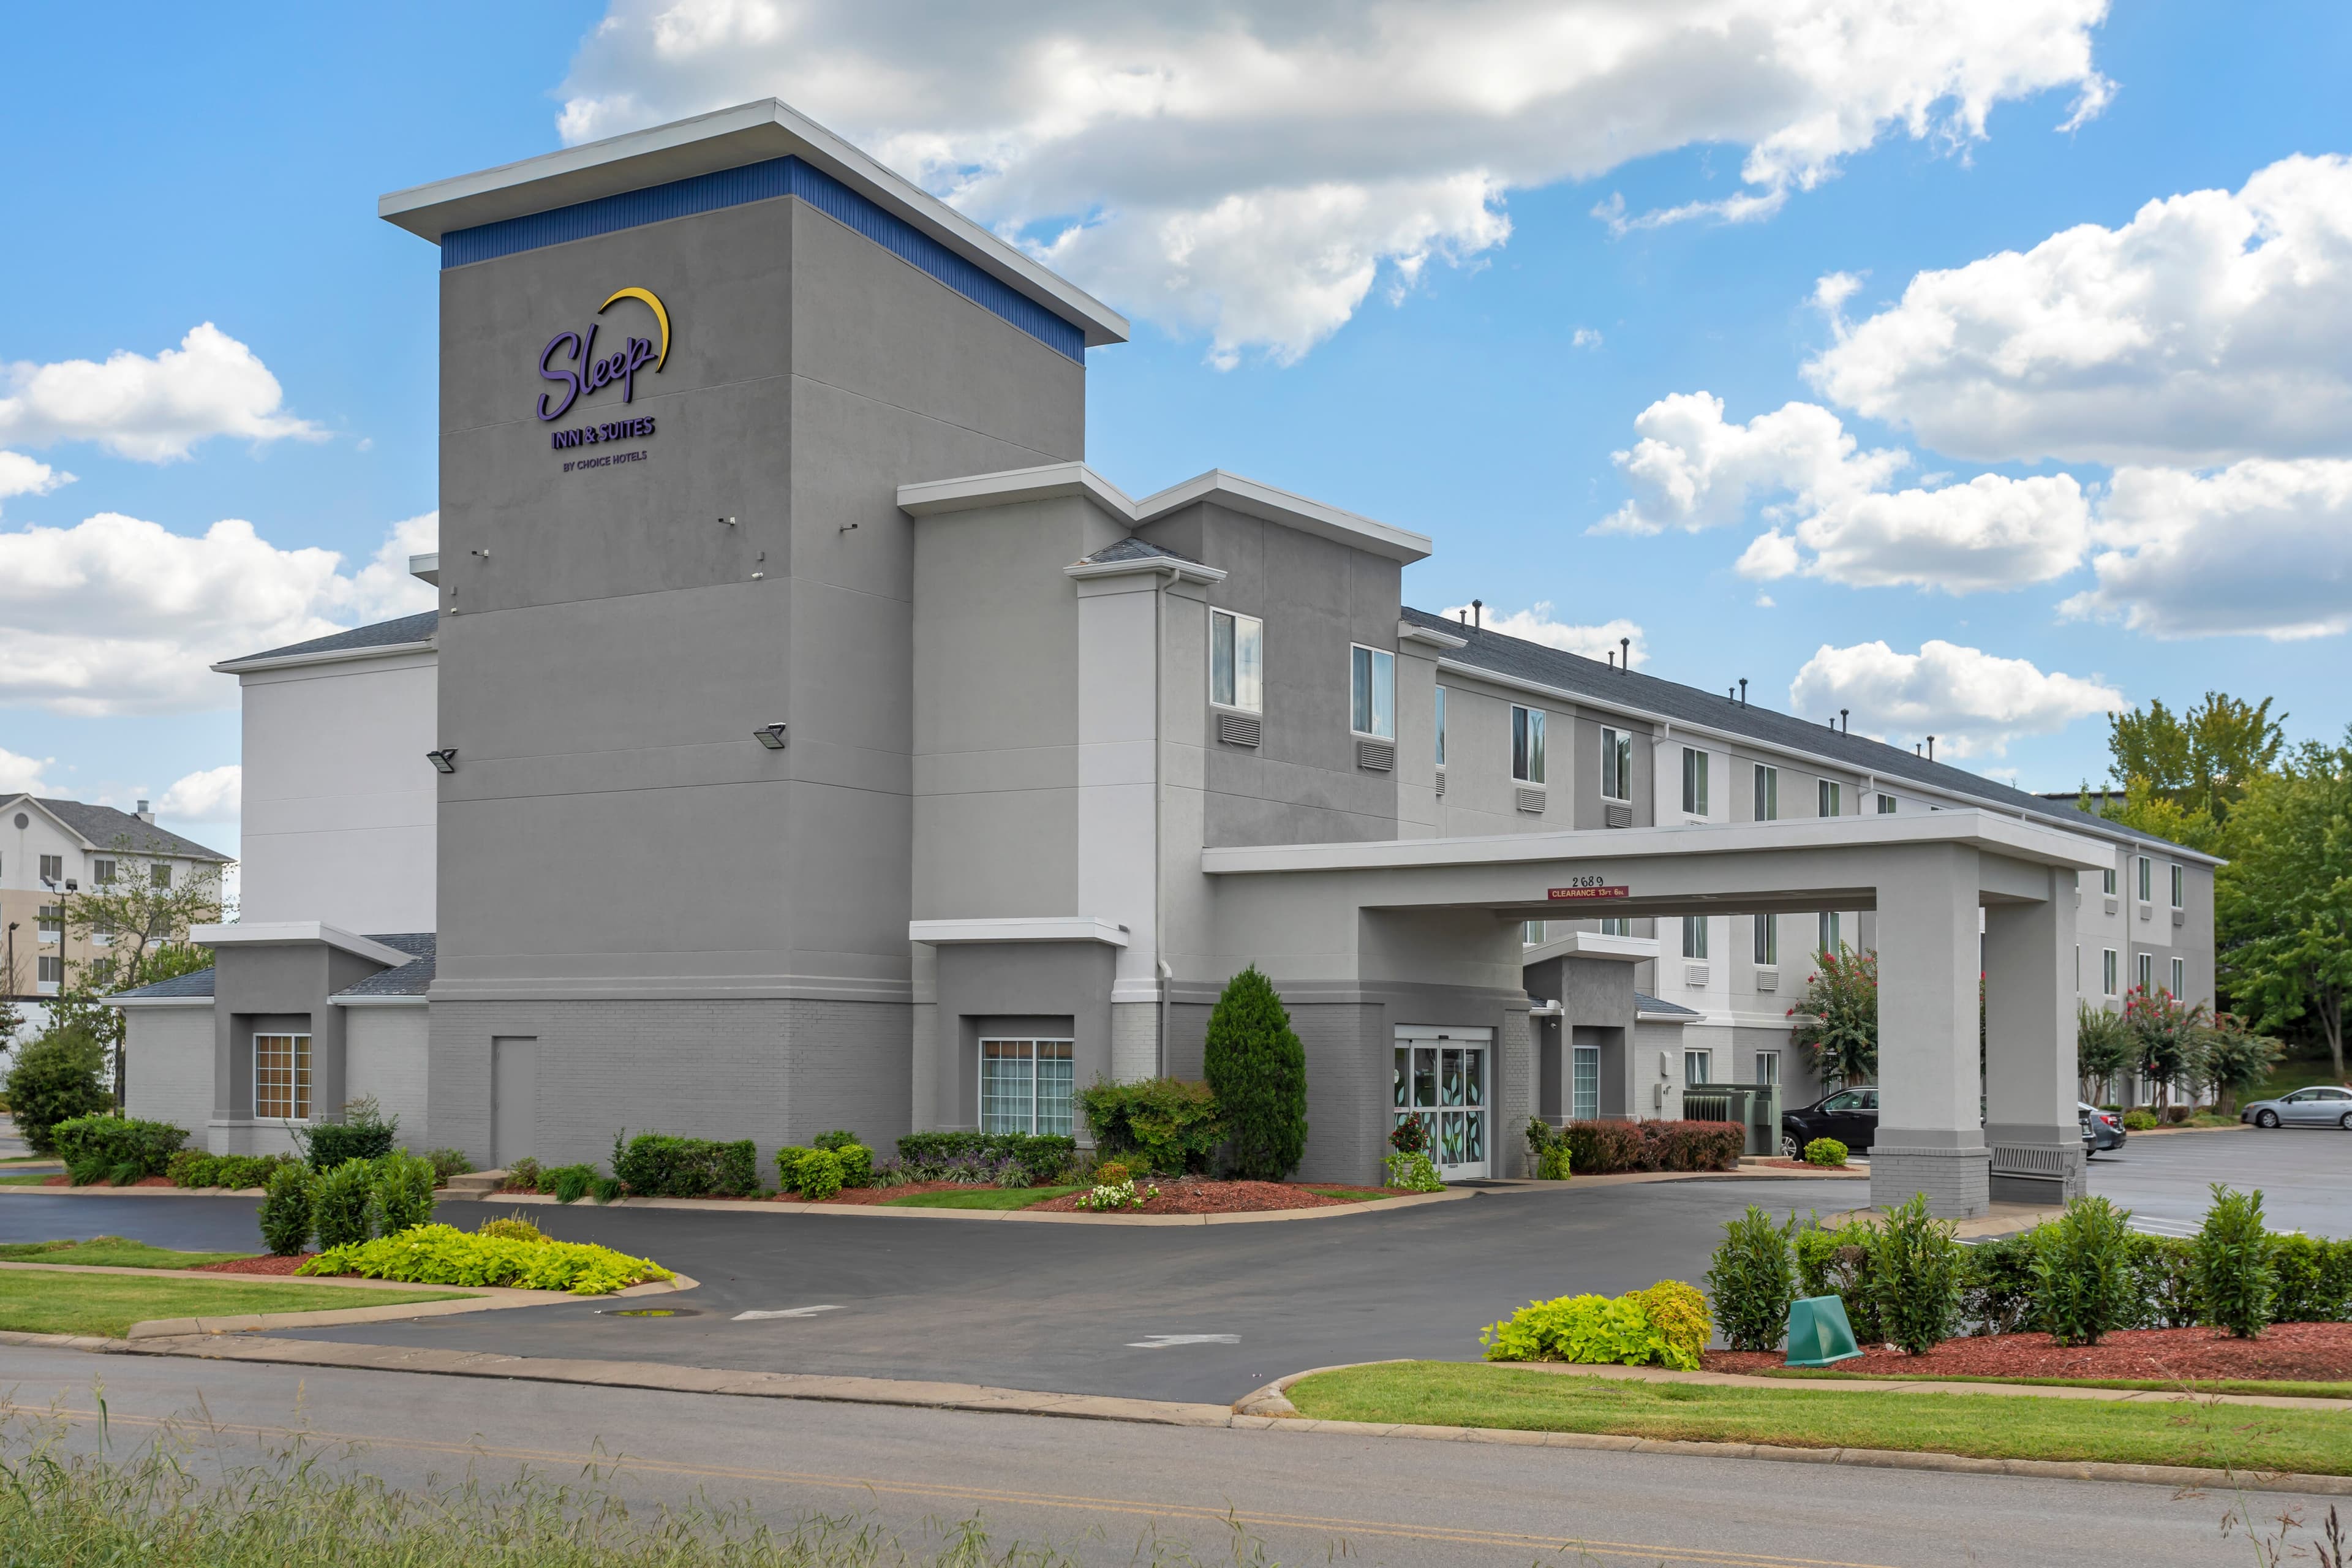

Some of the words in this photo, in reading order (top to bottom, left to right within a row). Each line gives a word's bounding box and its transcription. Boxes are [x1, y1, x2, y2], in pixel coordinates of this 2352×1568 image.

[537, 323, 658, 421] Sleep
[551, 428, 583, 449] INN
[584, 426, 599, 444] &
[598, 415, 655, 442] SUITES
[563, 461, 575, 472] BY
[576, 456, 611, 470] CHOICE
[612, 450, 647, 465] HOTELS
[1572, 876, 1604, 888] 2689
